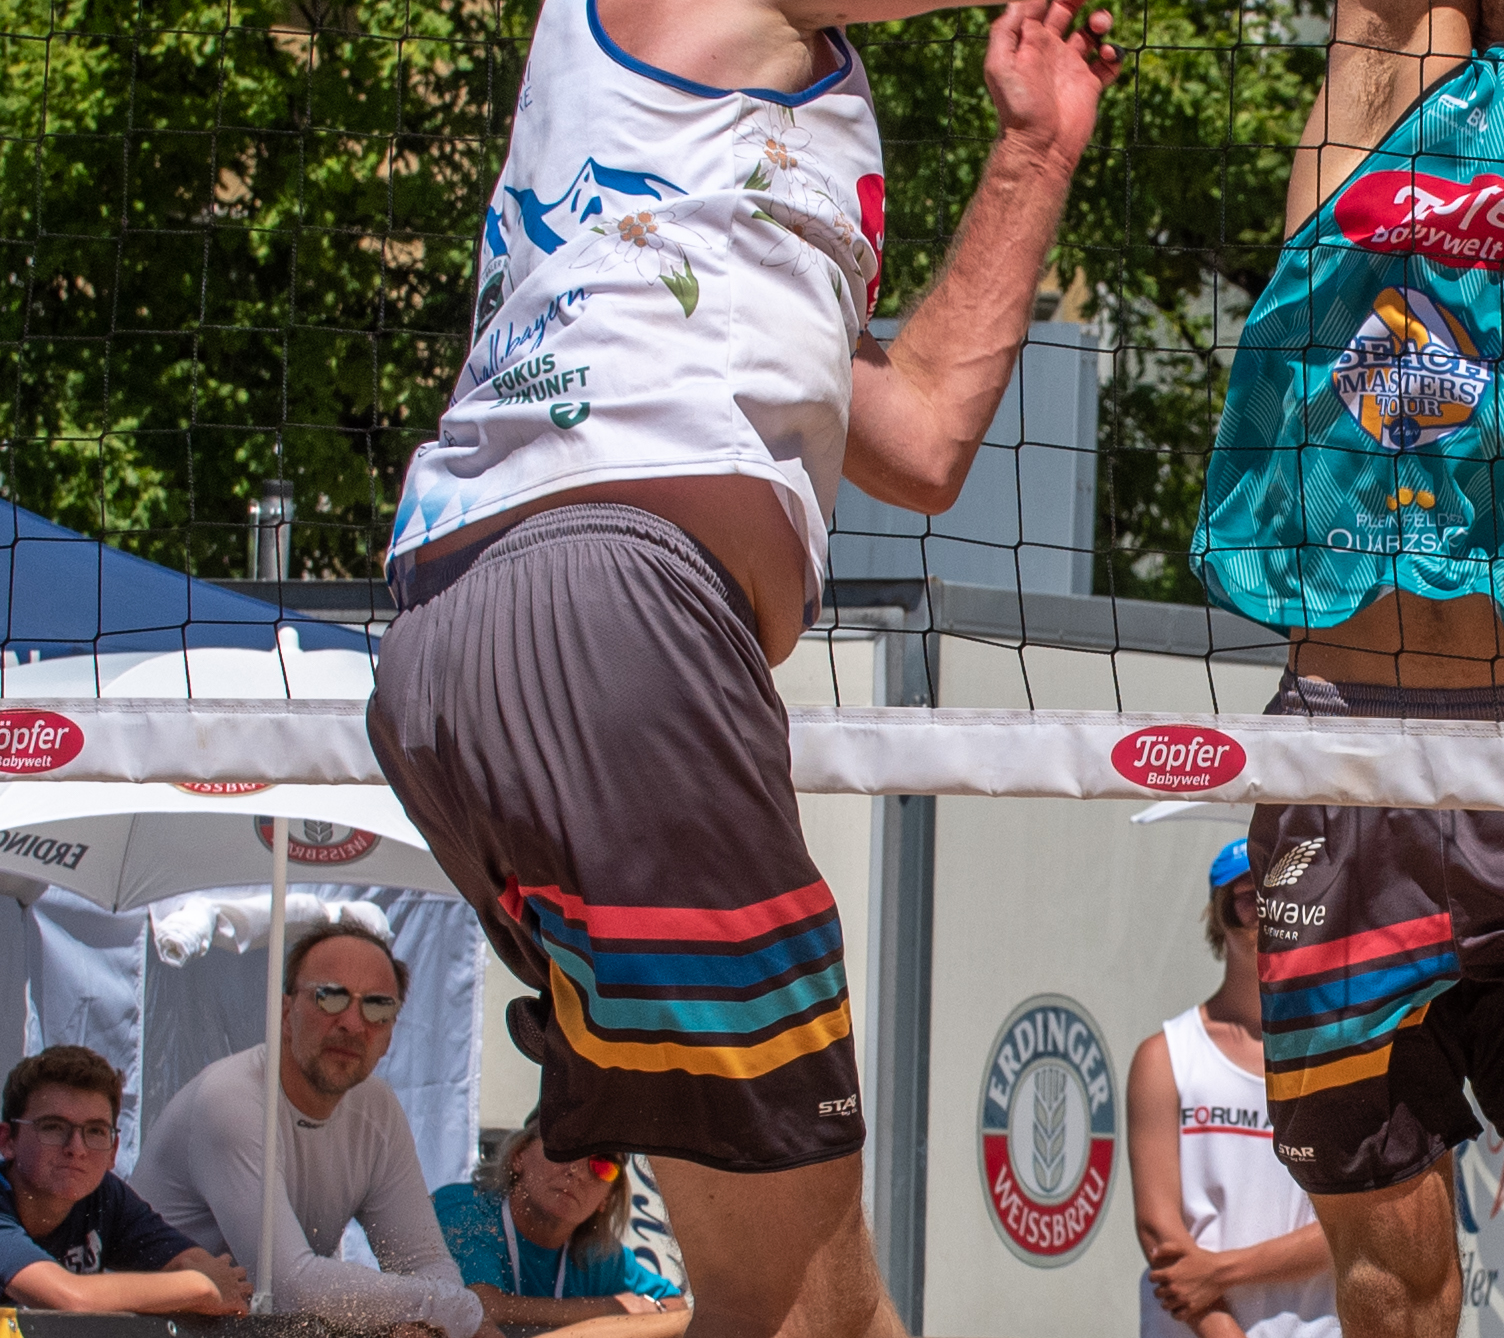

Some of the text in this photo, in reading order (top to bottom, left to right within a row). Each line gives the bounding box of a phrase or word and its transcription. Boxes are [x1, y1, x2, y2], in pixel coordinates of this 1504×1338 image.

[1370, 223, 1504, 261] Babywelt
[1334, 334, 1494, 383] BEACH
[1339, 368, 1480, 407] MASTERS
[1375, 394, 1443, 417] TOUR
[1133, 735, 1230, 772] Töpfer
[1146, 772, 1210, 788] Babywelt
[988, 1011, 1111, 1112] ERDINGER
[1181, 1106, 1258, 1127] FORUM
[1278, 1143, 1315, 1159] STAR
[993, 1163, 1106, 1248] WEISSBRÄU
